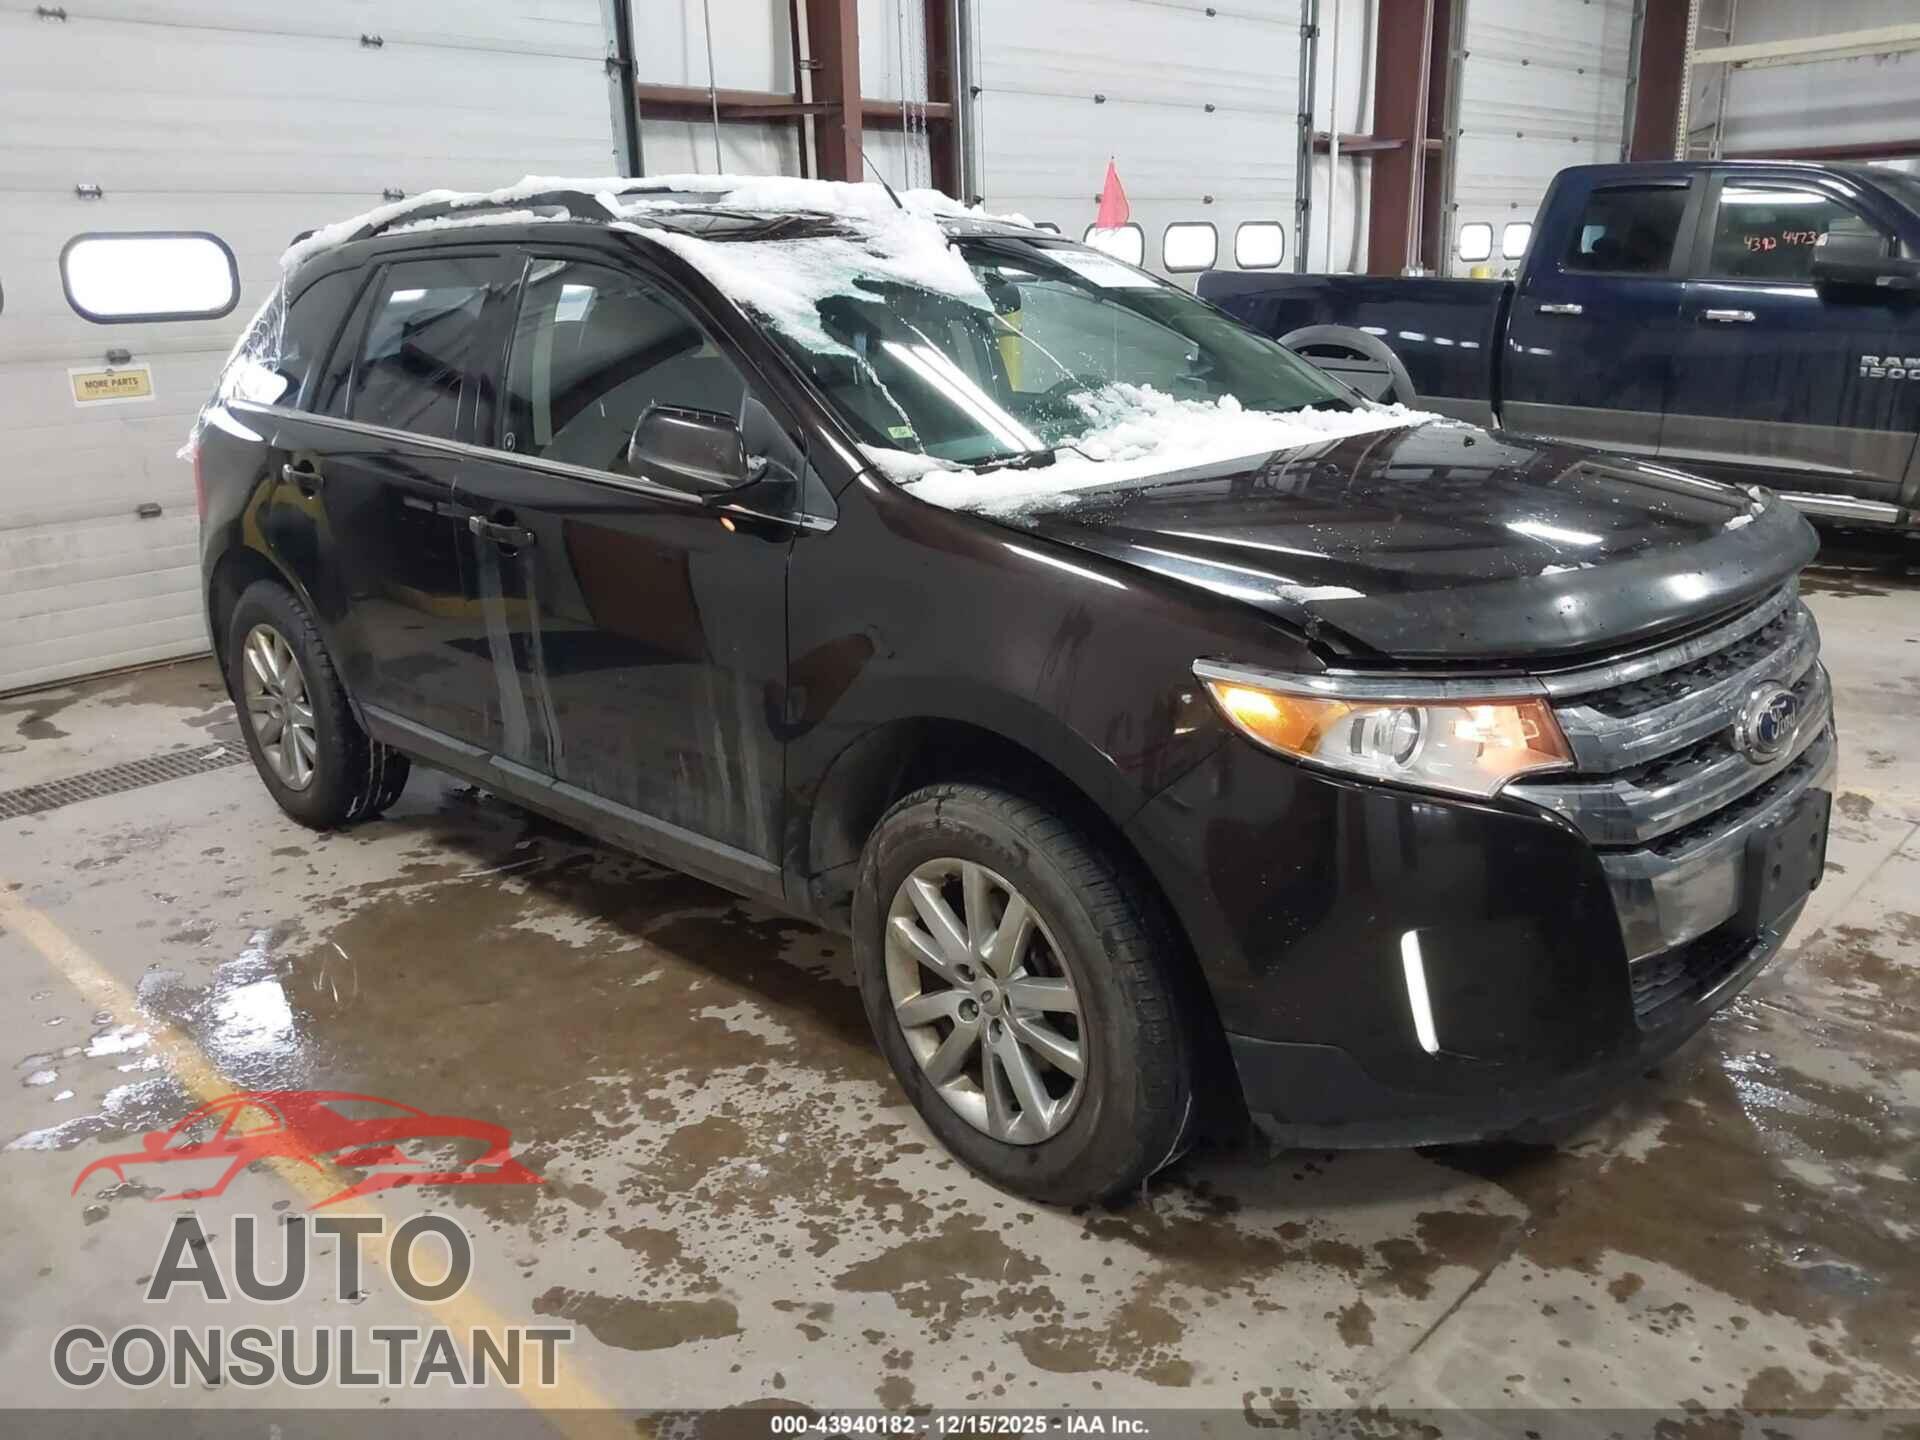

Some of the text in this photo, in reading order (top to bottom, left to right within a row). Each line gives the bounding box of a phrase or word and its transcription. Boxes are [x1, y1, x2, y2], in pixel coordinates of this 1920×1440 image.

[1860, 366, 1920, 380] 1500
[84, 377, 139, 389] MORE PARTS
